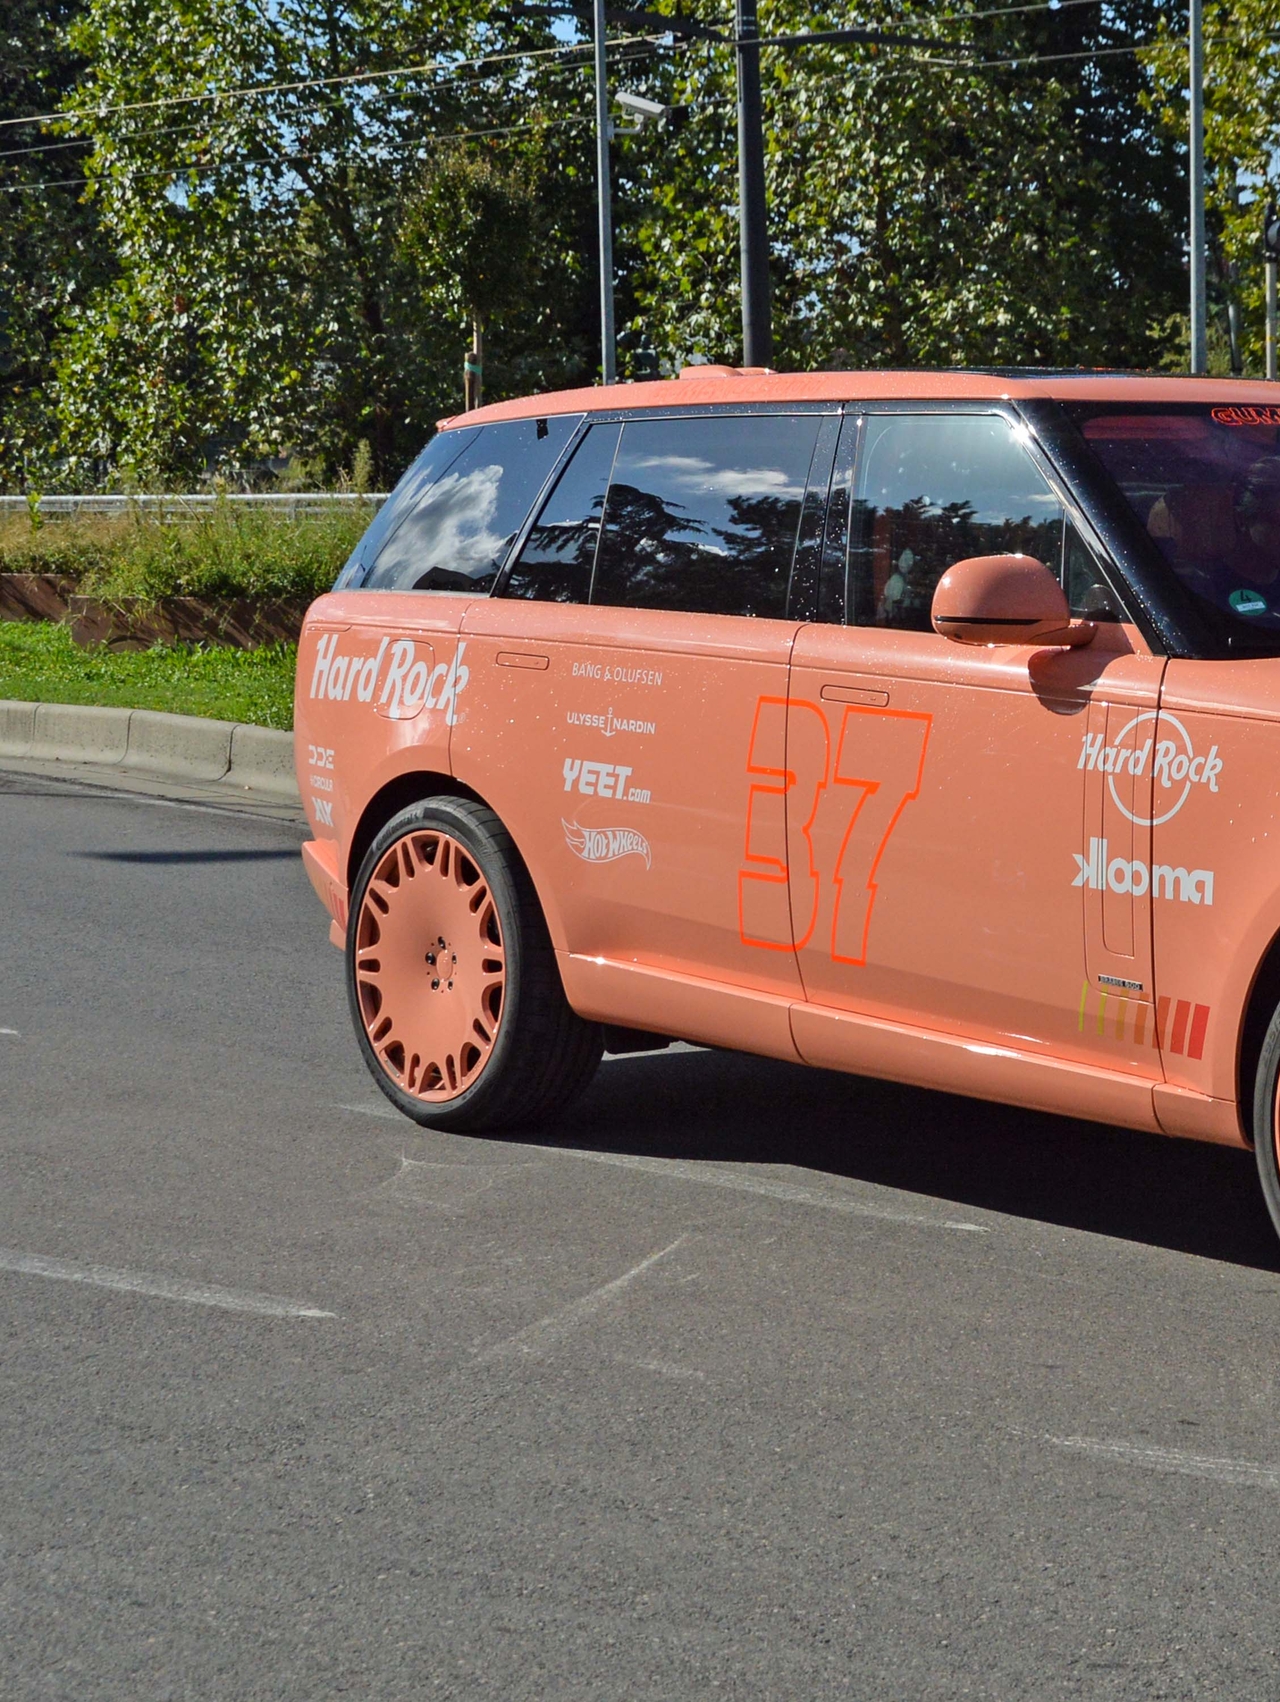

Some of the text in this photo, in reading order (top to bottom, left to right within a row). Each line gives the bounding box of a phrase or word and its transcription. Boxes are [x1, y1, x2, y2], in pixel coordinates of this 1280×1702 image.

[310, 634, 469, 726] Hard Rock
[572, 662, 663, 686] BANG & OLUFSEN
[566, 711, 656, 734] ULYSSE NARDIN
[562, 758, 651, 804] YEET.com
[1077, 733, 1223, 792] Hard Rock
[737, 695, 933, 967] 37
